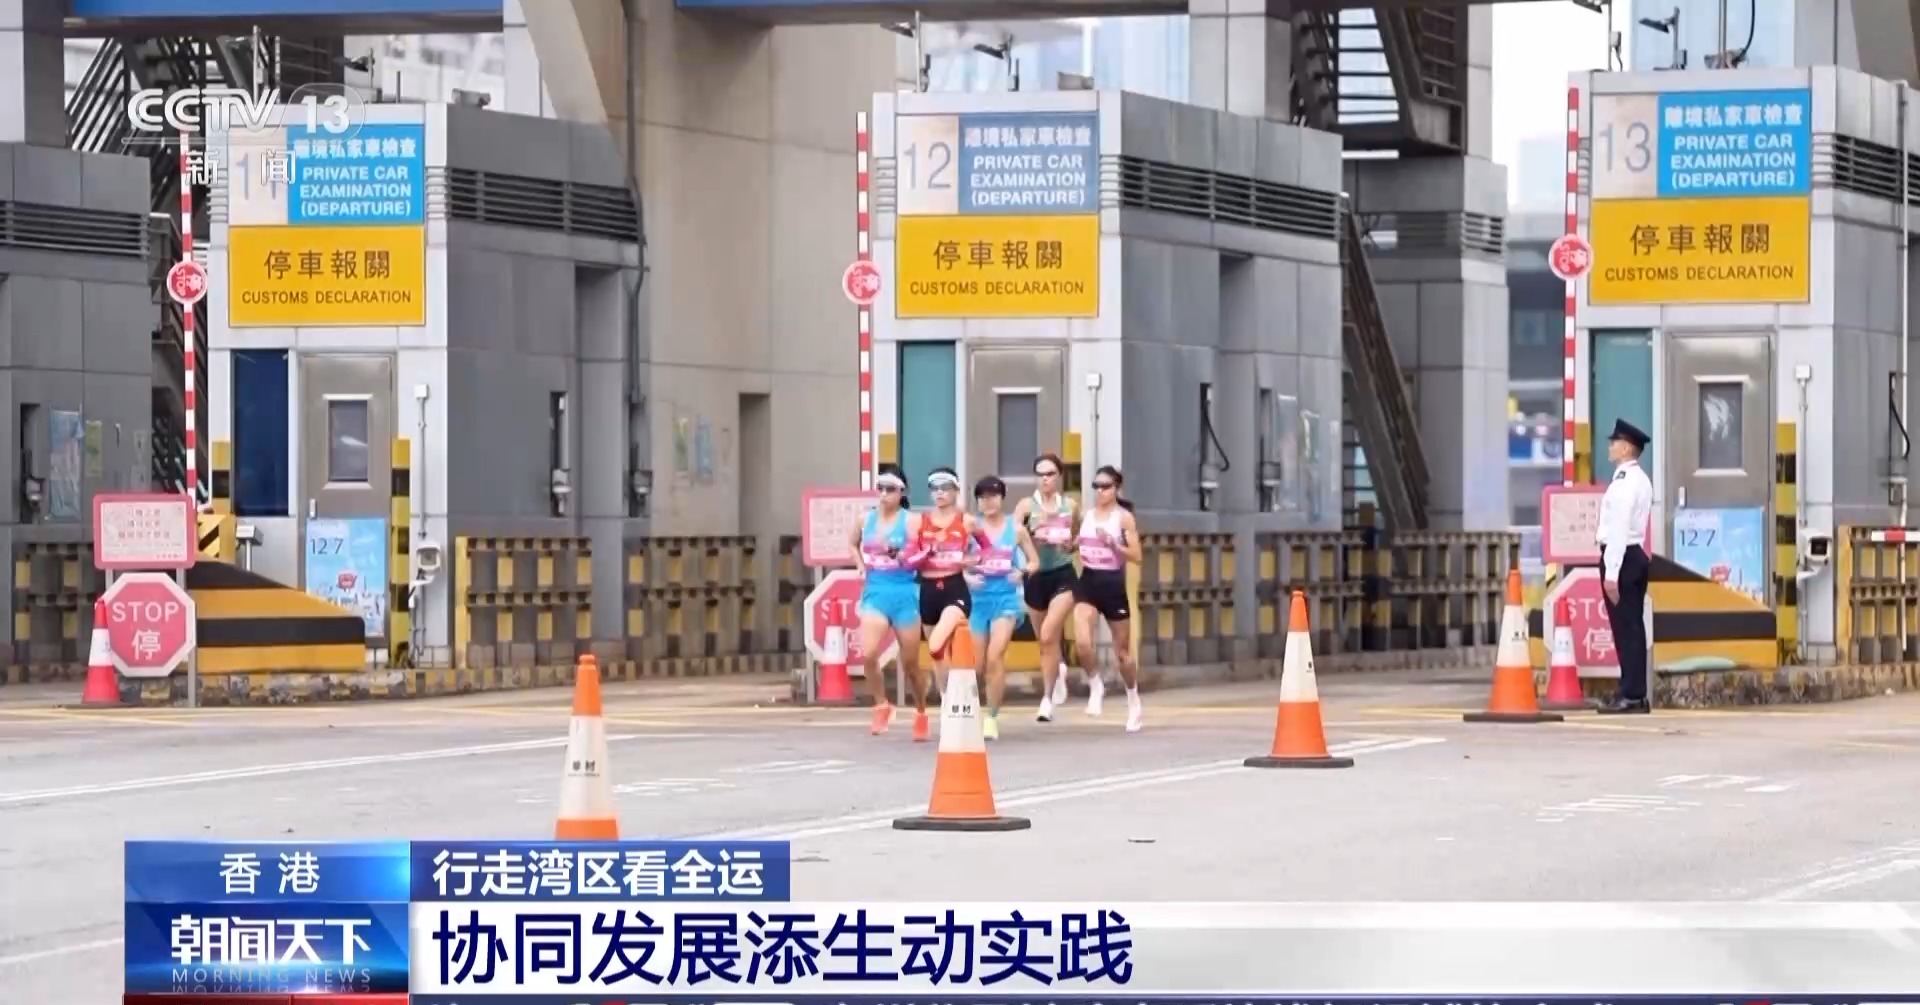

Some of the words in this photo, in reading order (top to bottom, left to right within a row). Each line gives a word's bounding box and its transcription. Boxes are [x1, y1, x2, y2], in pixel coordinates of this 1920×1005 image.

[1599, 121, 1652, 173] 13
[1674, 134, 1748, 150] PRIVATE
[1754, 134, 1793, 148] CAR
[904, 142, 952, 189] 12
[974, 155, 1042, 169] PRIVATE
[1048, 154, 1083, 168] CAR
[1670, 152, 1796, 169] EXAMINATION
[303, 166, 369, 180] PRIVATE
[374, 166, 408, 179] CAR
[970, 173, 1086, 187] EXAMINATION
[1671, 170, 1795, 189] (DEPARTURE)
[300, 183, 412, 199] EXAMINATION
[971, 190, 1085, 207] (DEPARTURE)
[301, 200, 411, 217] (DEPARTURE)
[1630, 224, 1770, 256] 停車報關
[933, 240, 1063, 270] 停車報關
[263, 250, 391, 280] 停車報關
[1605, 266, 1679, 281] CUSTOMS
[1686, 265, 1794, 280] DECLARATION
[910, 281, 978, 295] CUSTOMS
[985, 281, 1084, 295] DECLARATION
[242, 290, 309, 304] CUSTOMS
[316, 290, 411, 304] DECLARATION
[112, 602, 179, 622] STOP
[132, 629, 161, 660] 停
[1582, 628, 1615, 660] 停
